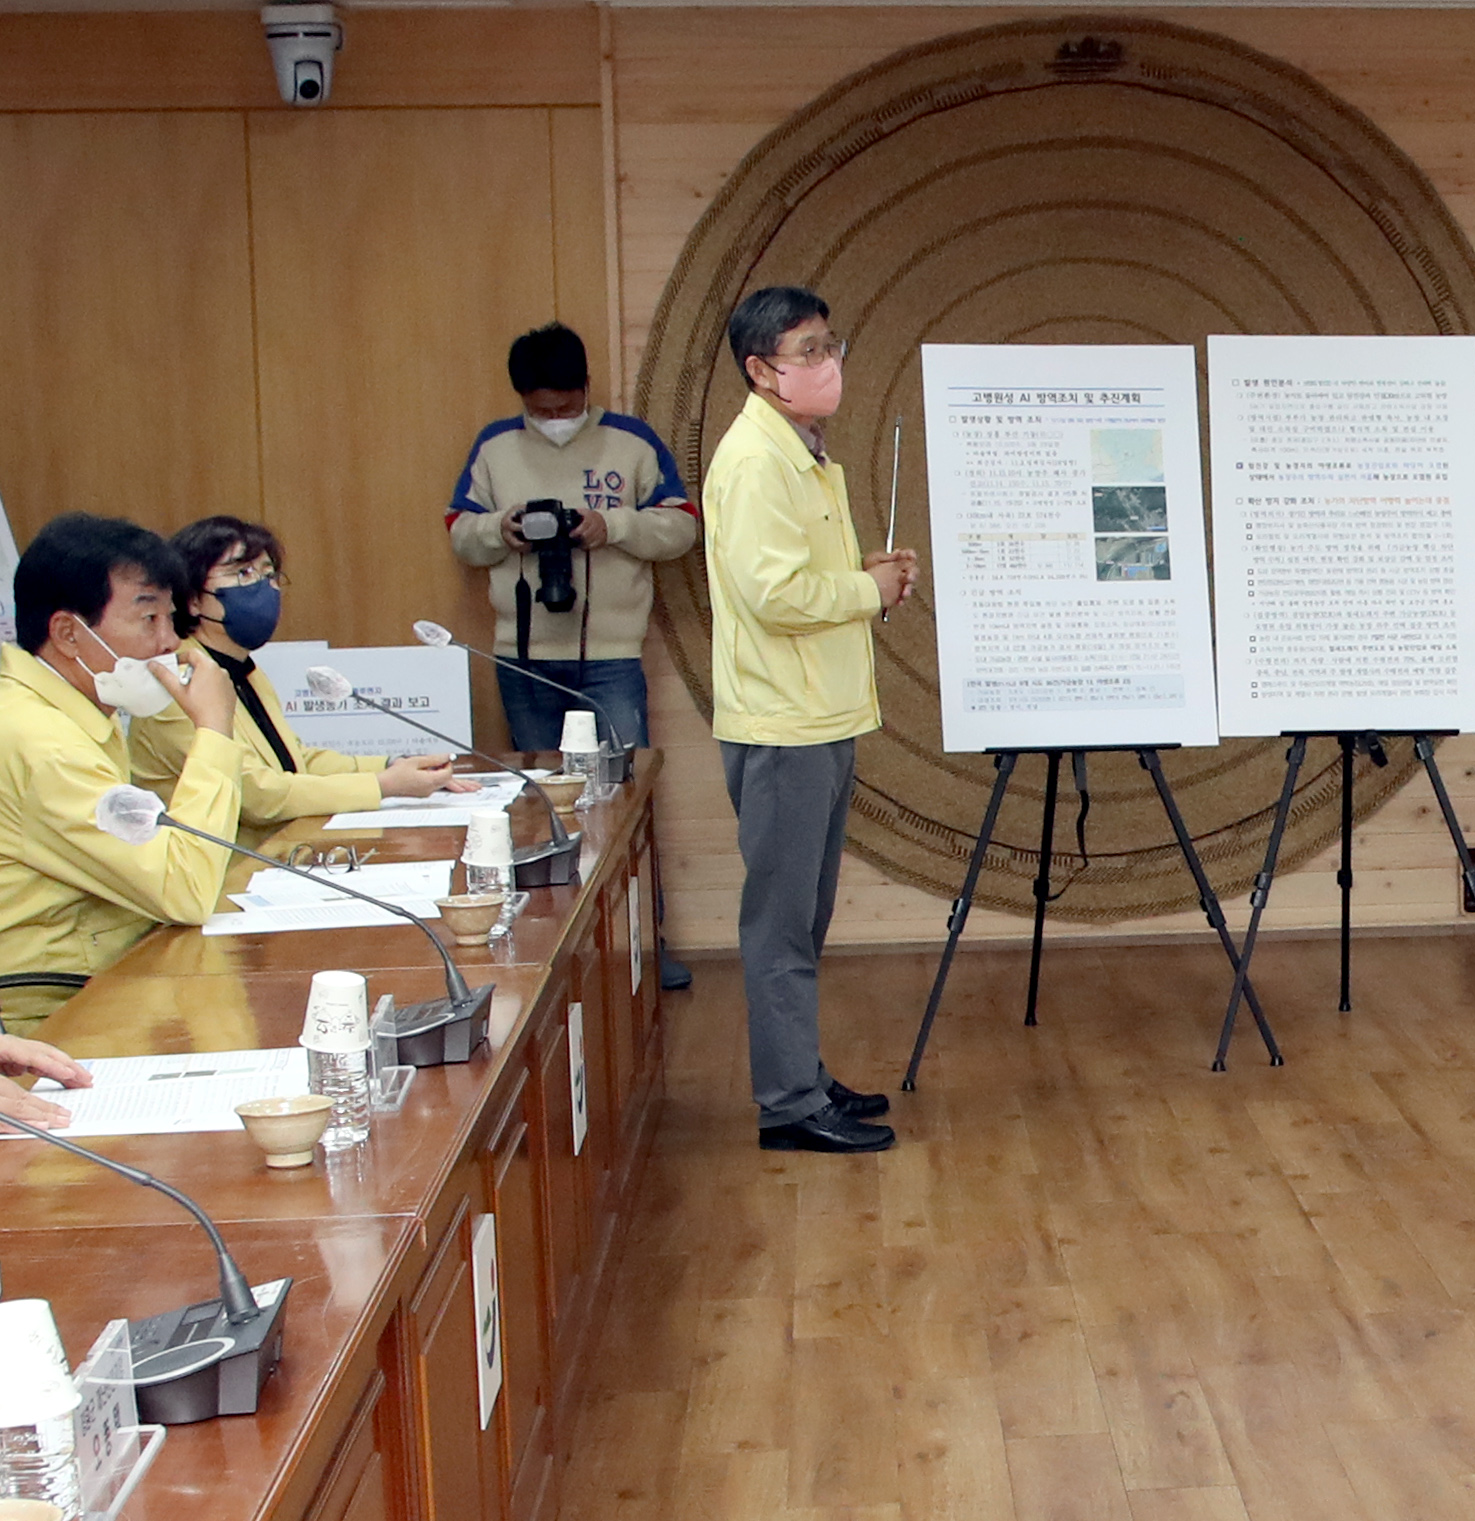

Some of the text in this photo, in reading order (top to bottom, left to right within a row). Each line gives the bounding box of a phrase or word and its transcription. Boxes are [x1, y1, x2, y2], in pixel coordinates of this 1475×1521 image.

[972, 391, 1142, 404] 고병원성 AI 방역조치 및 추진계획
[583, 469, 625, 493] LO
[285, 700, 298, 712] AI
[303, 699, 348, 712] 발생농가
[408, 696, 431, 709] 보고
